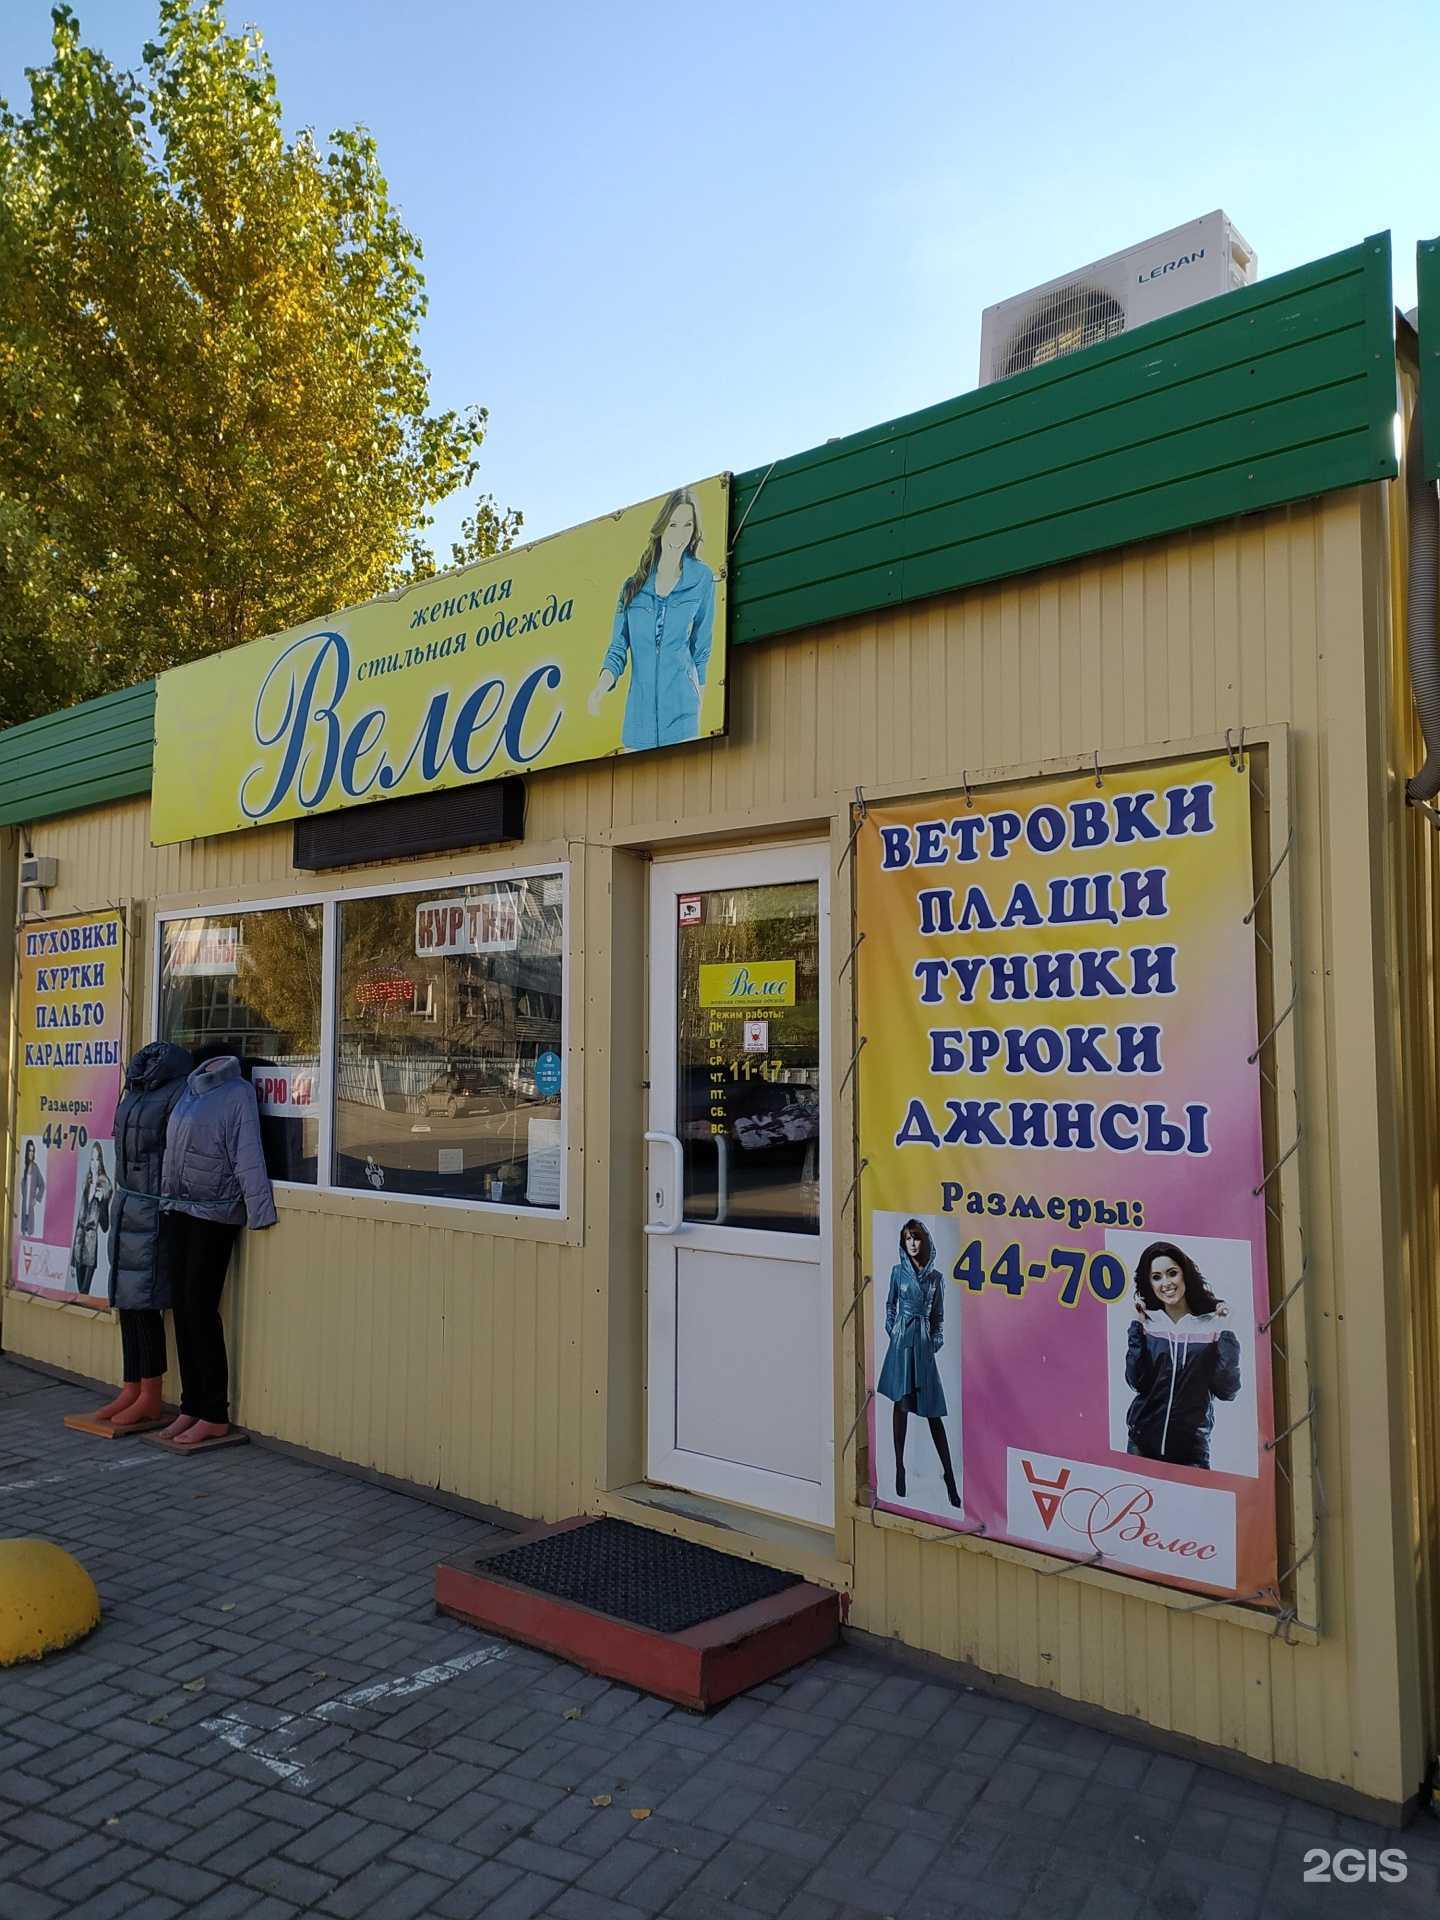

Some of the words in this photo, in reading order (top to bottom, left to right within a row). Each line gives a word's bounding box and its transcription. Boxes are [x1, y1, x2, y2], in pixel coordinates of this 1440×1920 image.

[1138, 249, 1205, 284] LERAN
[410, 578, 513, 629] женская
[357, 632, 467, 682] стильная
[475, 594, 574, 647] одежда
[240, 630, 562, 819] Велес
[881, 784, 1214, 869] ВЕТРОВКИ
[919, 869, 1168, 933] ПЛАЩИ
[26, 922, 118, 955] ПУХОВИКИ
[36, 963, 105, 992] КУРТКИ
[728, 967, 787, 996] Велес
[914, 946, 1176, 1003] ТУНИКИ
[36, 1002, 105, 1028] ПАЛЬТО
[710, 1009, 742, 1019] Режим
[745, 1009, 785, 1020] работы:
[25, 1041, 119, 1068] КАРДИГАНЫ
[709, 1039, 725, 1049] ВТ.
[930, 1025, 1163, 1074] БРЮКИ
[709, 1056, 726, 1066] СР.
[730, 1060, 782, 1081] 11-17
[710, 1072, 726, 1082] ЧТ.
[40, 1096, 93, 1114] Размеры:
[710, 1089, 727, 1100] ПТ.
[710, 1106, 727, 1117] СБ.
[42, 1123, 88, 1150] 44-70
[710, 1124, 727, 1134] ВС.
[896, 1100, 1210, 1154] ДЖИНСЫ
[941, 1181, 1144, 1228] Размеры:
[953, 1240, 1126, 1304] 44-70
[1060, 1484, 1218, 1561] Велес
